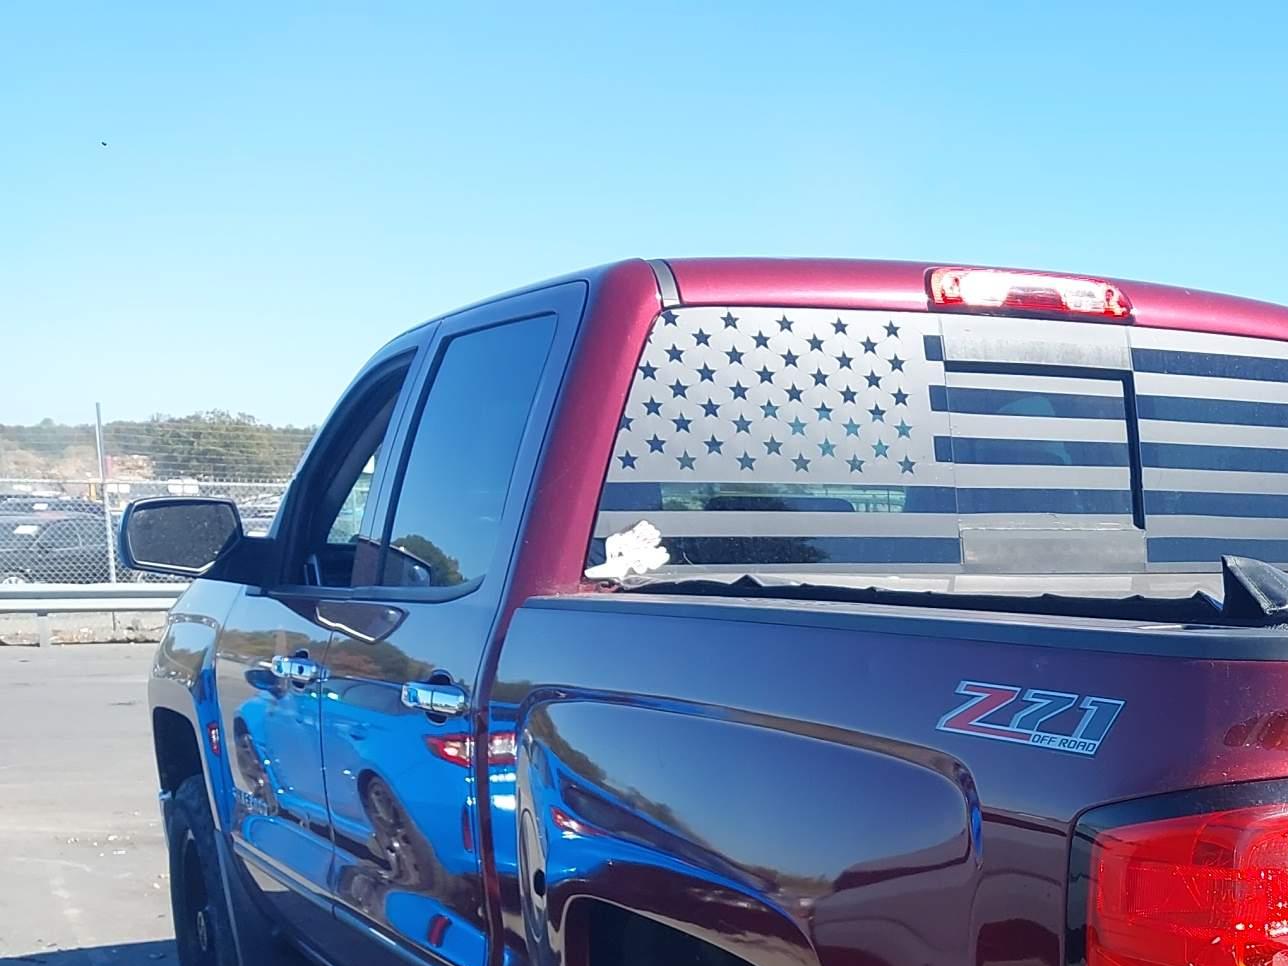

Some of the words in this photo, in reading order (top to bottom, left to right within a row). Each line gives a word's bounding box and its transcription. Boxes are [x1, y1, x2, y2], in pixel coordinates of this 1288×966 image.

[936, 680, 1127, 743] Z71
[1031, 733, 1057, 746] OFF
[1058, 737, 1097, 753] ROAD
